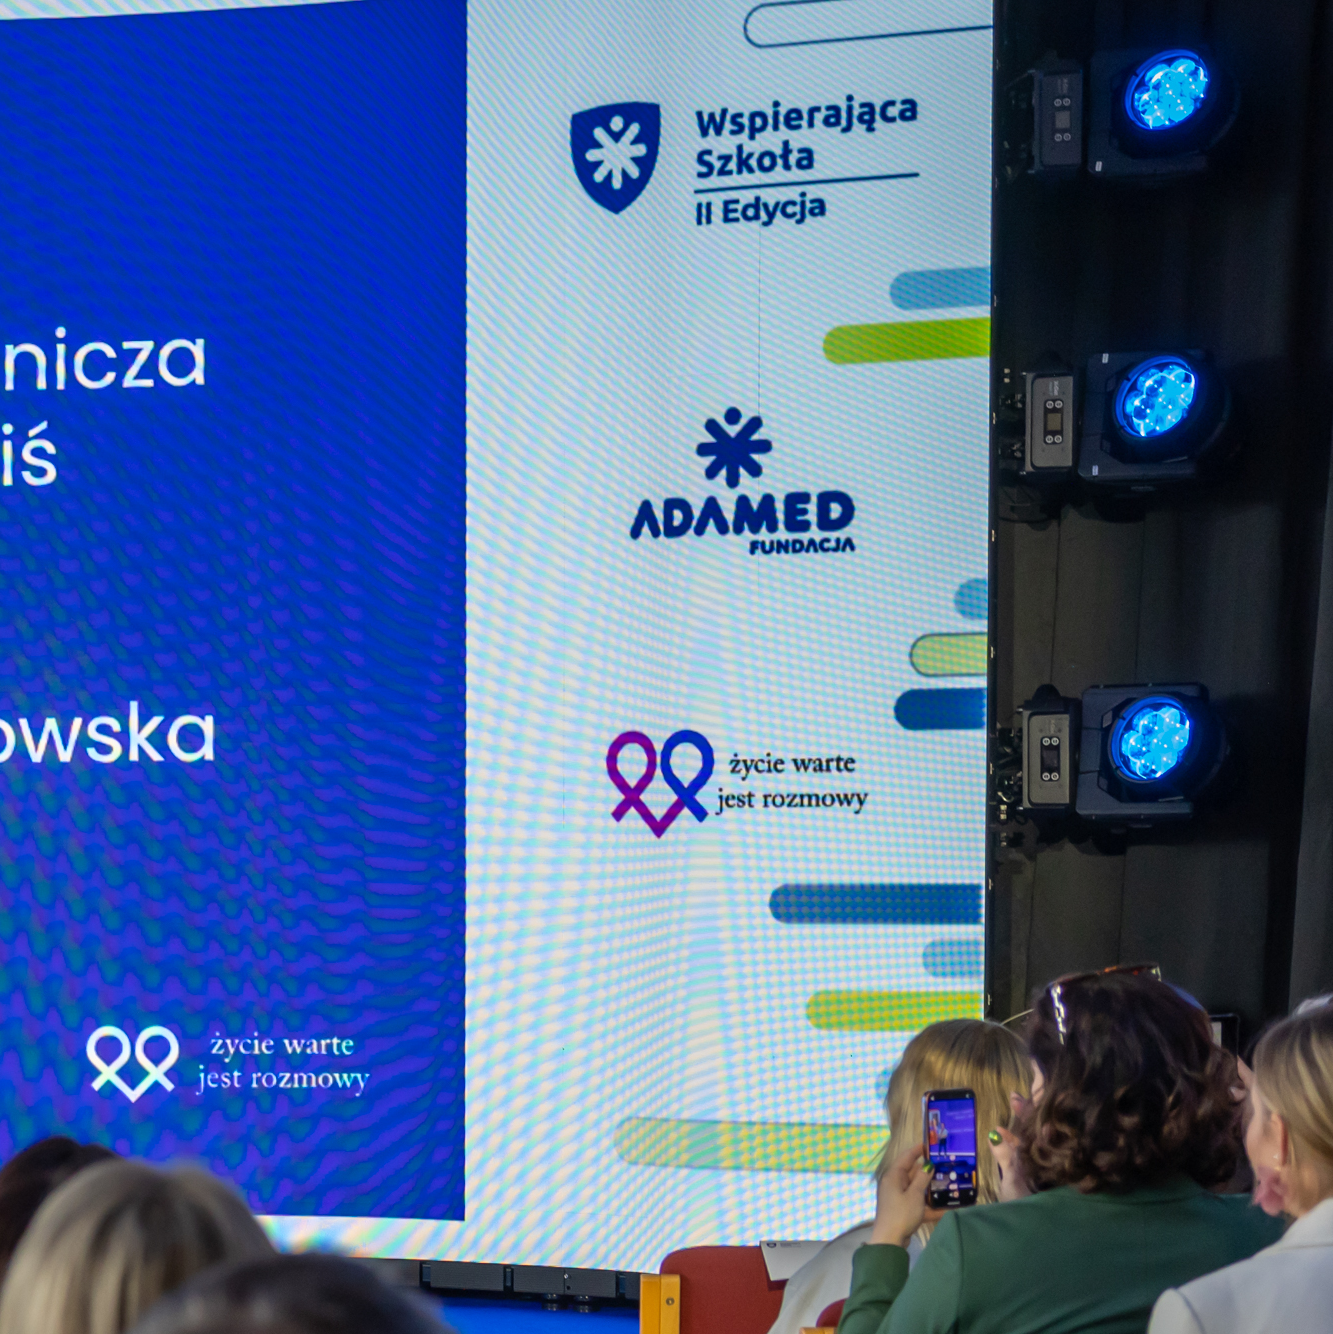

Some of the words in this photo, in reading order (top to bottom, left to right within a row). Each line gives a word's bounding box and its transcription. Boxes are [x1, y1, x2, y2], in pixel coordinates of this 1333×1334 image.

[695, 94, 919, 141] Wspierająca
[696, 140, 815, 178] Szkoła
[695, 201, 712, 225] II
[722, 192, 826, 226] Edycja
[630, 490, 856, 540] ADAMED
[749, 537, 856, 555] FUNDACJA
[729, 753, 785, 781] życie
[791, 755, 856, 774] warte
[715, 787, 755, 815] jest
[762, 789, 868, 813] rozmowy
[210, 1031, 275, 1063] życie
[283, 1036, 354, 1055] warte
[196, 1064, 242, 1095] jest
[251, 1070, 370, 1097] rozmowy
